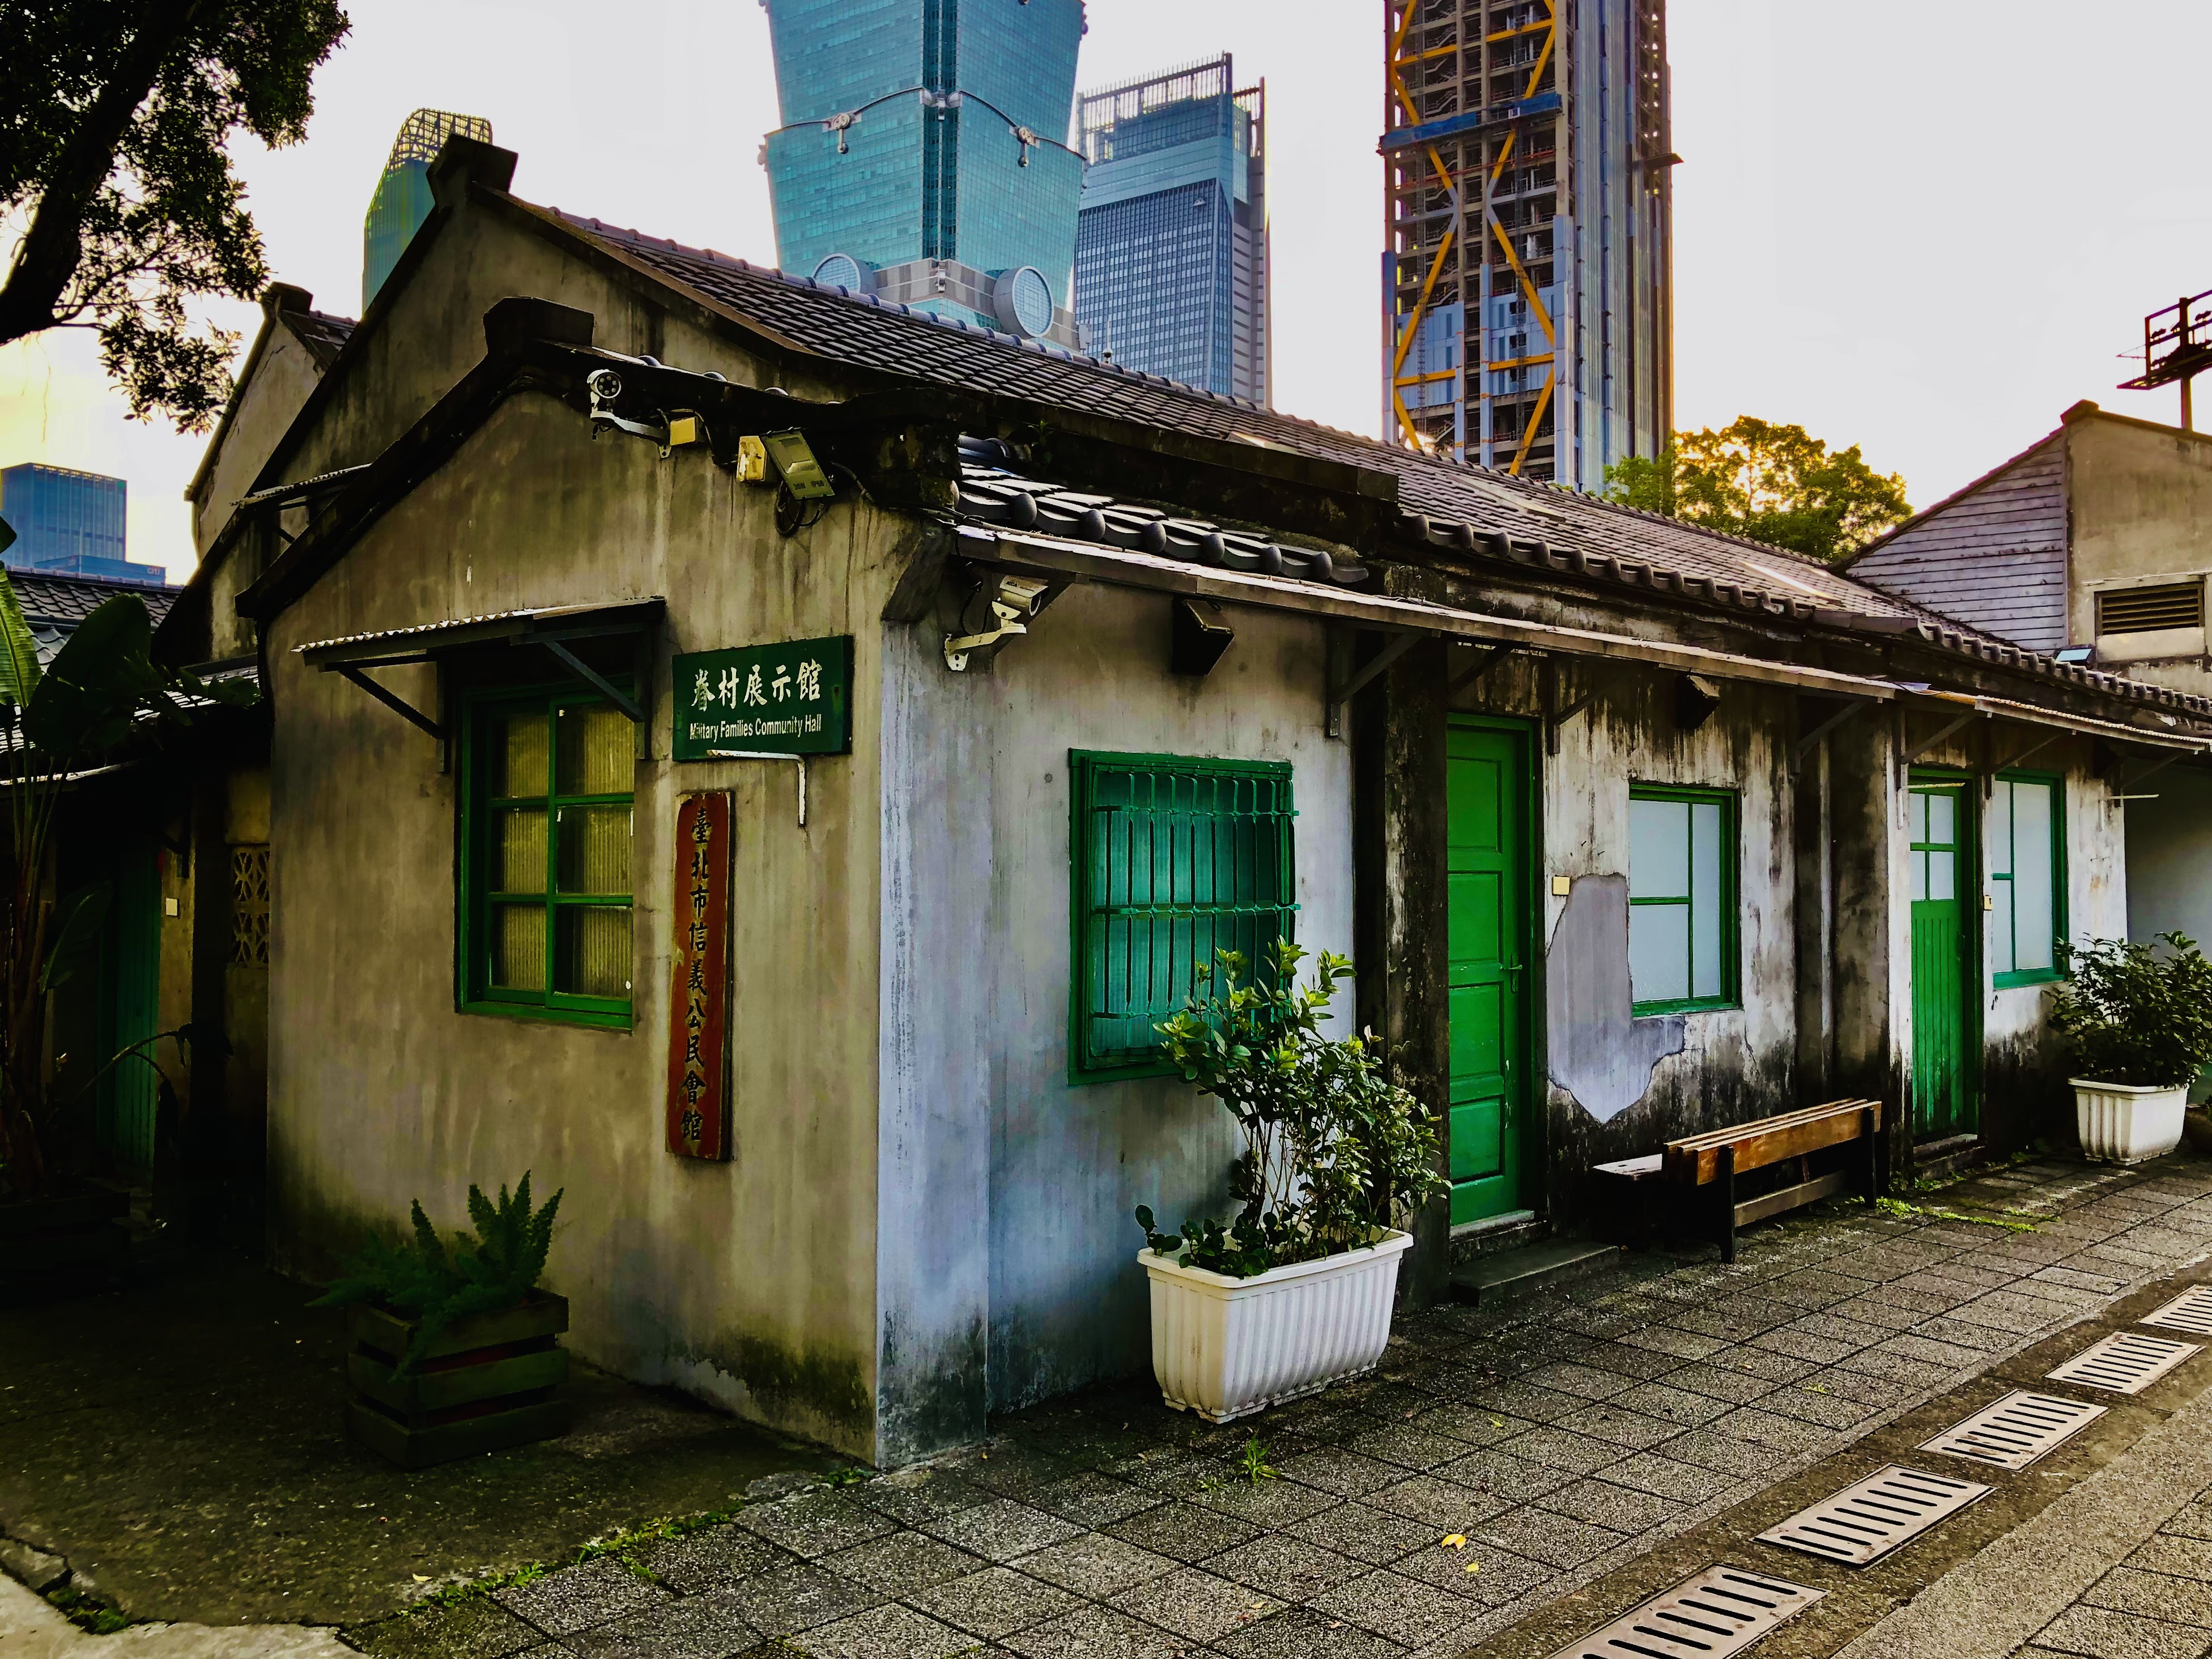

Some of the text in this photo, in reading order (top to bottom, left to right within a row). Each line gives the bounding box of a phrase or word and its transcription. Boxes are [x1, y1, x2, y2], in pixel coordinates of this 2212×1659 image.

[691, 658, 822, 712] 眷村展示館
[690, 714, 822, 742] Military Families Community Hall
[680, 806, 712, 1139] 臺北市信義公民會館
